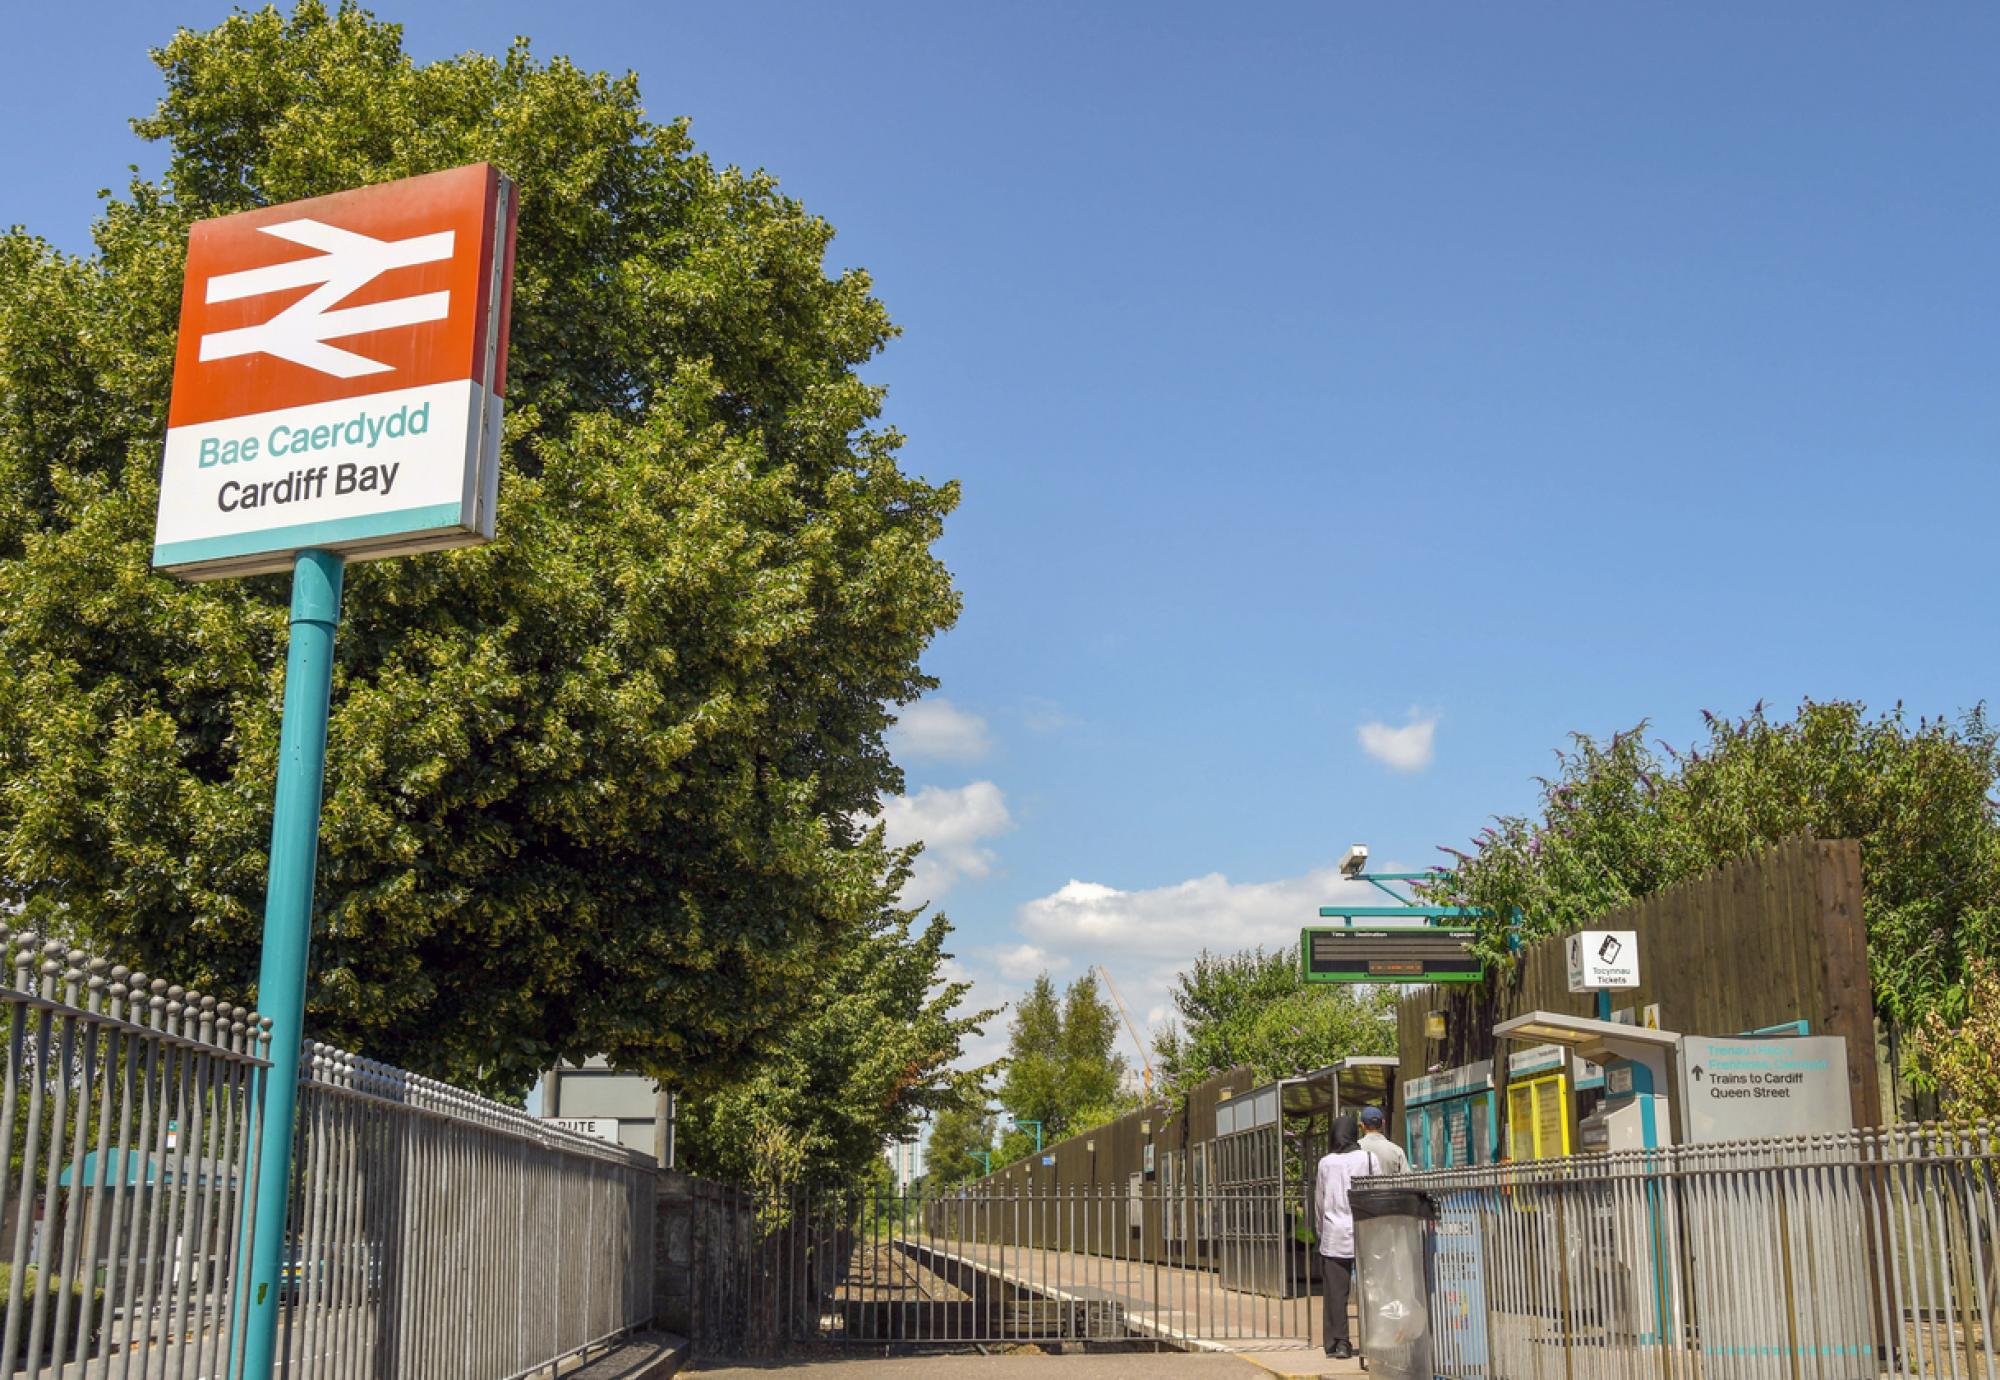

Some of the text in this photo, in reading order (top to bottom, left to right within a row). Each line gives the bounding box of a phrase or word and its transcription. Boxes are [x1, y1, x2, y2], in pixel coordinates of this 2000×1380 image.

[198, 401, 430, 469] Bae Caerdydd
[217, 462, 400, 513] Cardiff Bay
[1709, 1072, 1803, 1084] Trains to Cardiff
[1710, 1086, 1790, 1098] Queen Street
